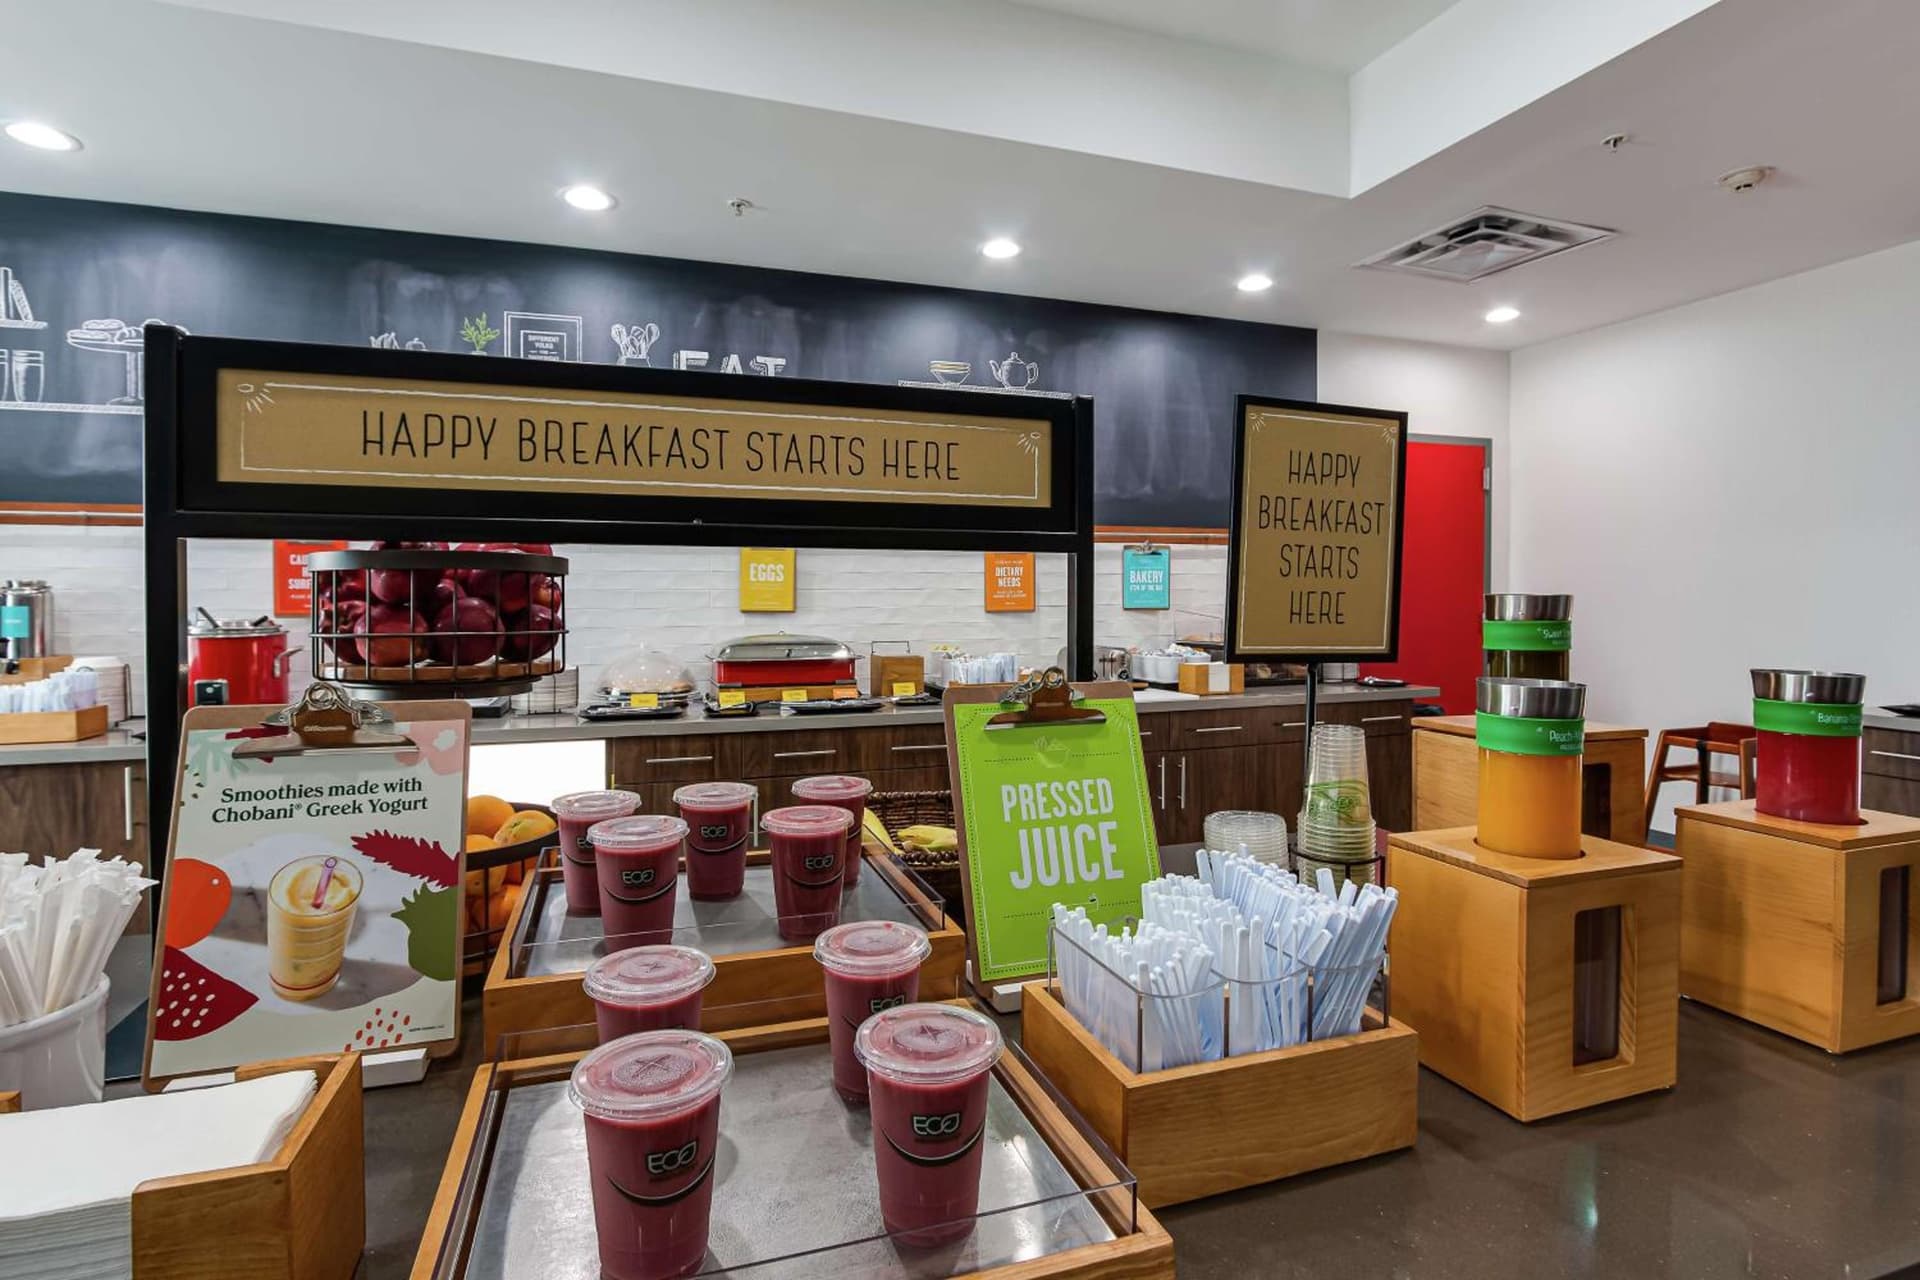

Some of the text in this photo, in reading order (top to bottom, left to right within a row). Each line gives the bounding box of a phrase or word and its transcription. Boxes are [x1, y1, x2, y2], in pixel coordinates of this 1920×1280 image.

[362, 410, 961, 481] HAPPY BREAKFAST STARTS HERE
[1288, 449, 1361, 489] HAPPY
[1258, 494, 1386, 535] BREAKFAST
[750, 562, 785, 582] EGGS
[995, 566, 1024, 577] DIETARY
[1129, 569, 1164, 584] BAKERY
[1279, 543, 1360, 580] STARTS
[998, 576, 1022, 588] NEEDS
[1289, 590, 1347, 625] HERE
[220, 776, 423, 804] Smoothies made with
[1000, 777, 1115, 824] PRESSED
[306, 799, 364, 818] Greek
[368, 796, 429, 816] Yogurt
[1008, 821, 1125, 890] JUICE
[621, 868, 656, 886] ECO
[912, 1112, 962, 1136] ECO
[647, 1140, 698, 1174] ECO
